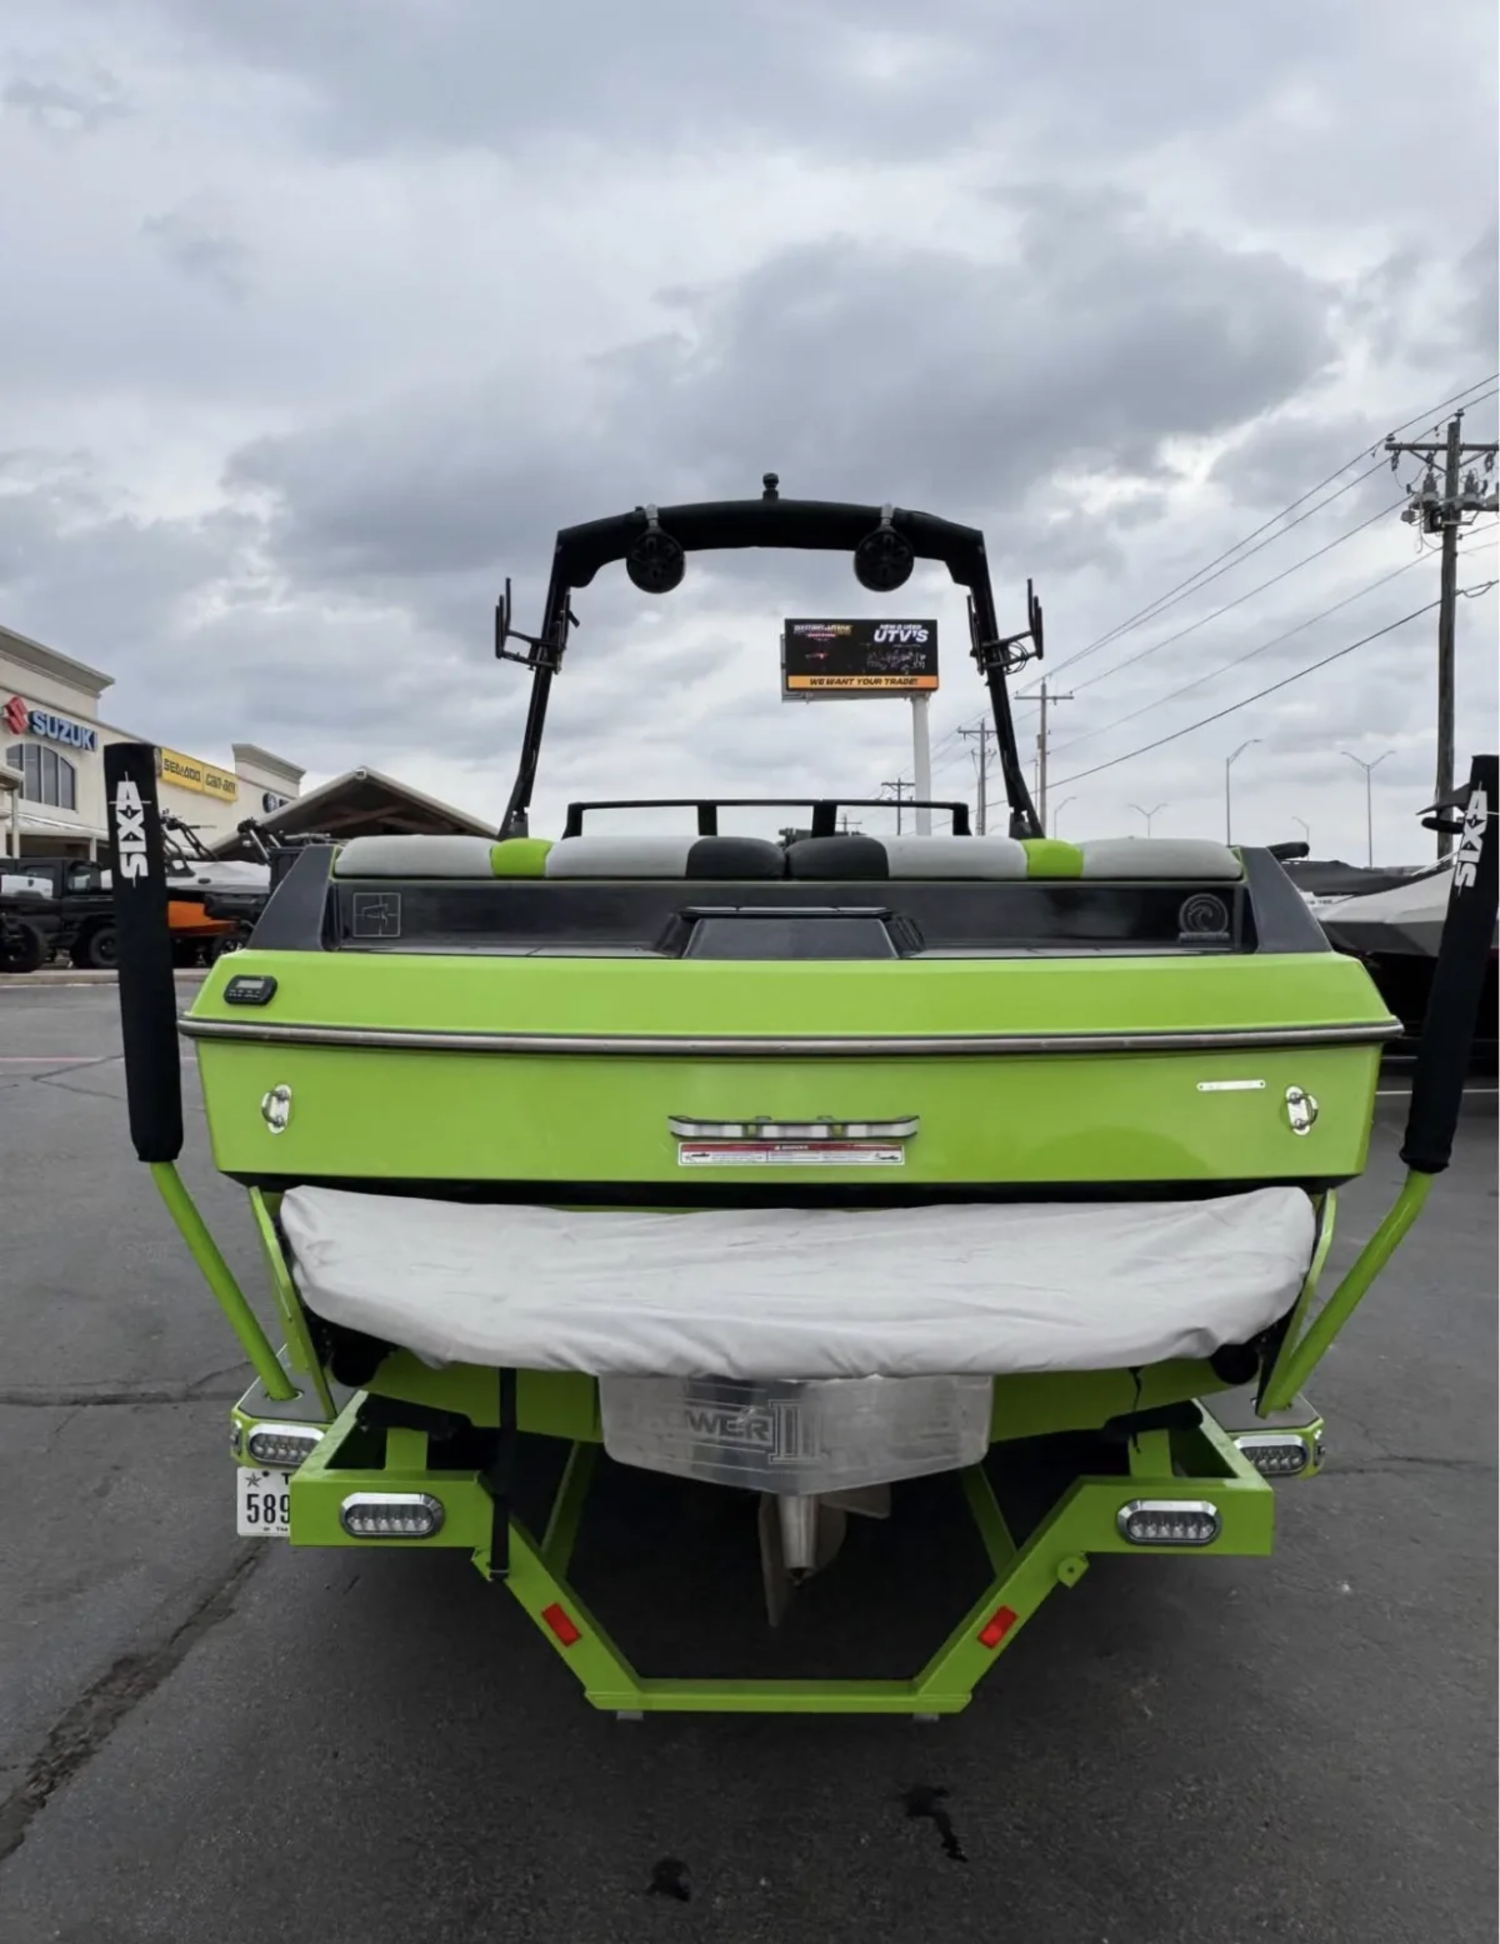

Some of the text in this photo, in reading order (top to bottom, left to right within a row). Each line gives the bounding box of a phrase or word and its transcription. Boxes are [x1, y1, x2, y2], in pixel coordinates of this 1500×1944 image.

[873, 629, 929, 643] UTV'S
[810, 678, 825, 686] WE
[826, 678, 855, 686] WANT
[856, 678, 883, 686] YOUR
[31, 710, 98, 751] SUZUKI
[115, 779, 149, 880] AXIS
[1454, 790, 1488, 888] AXIS
